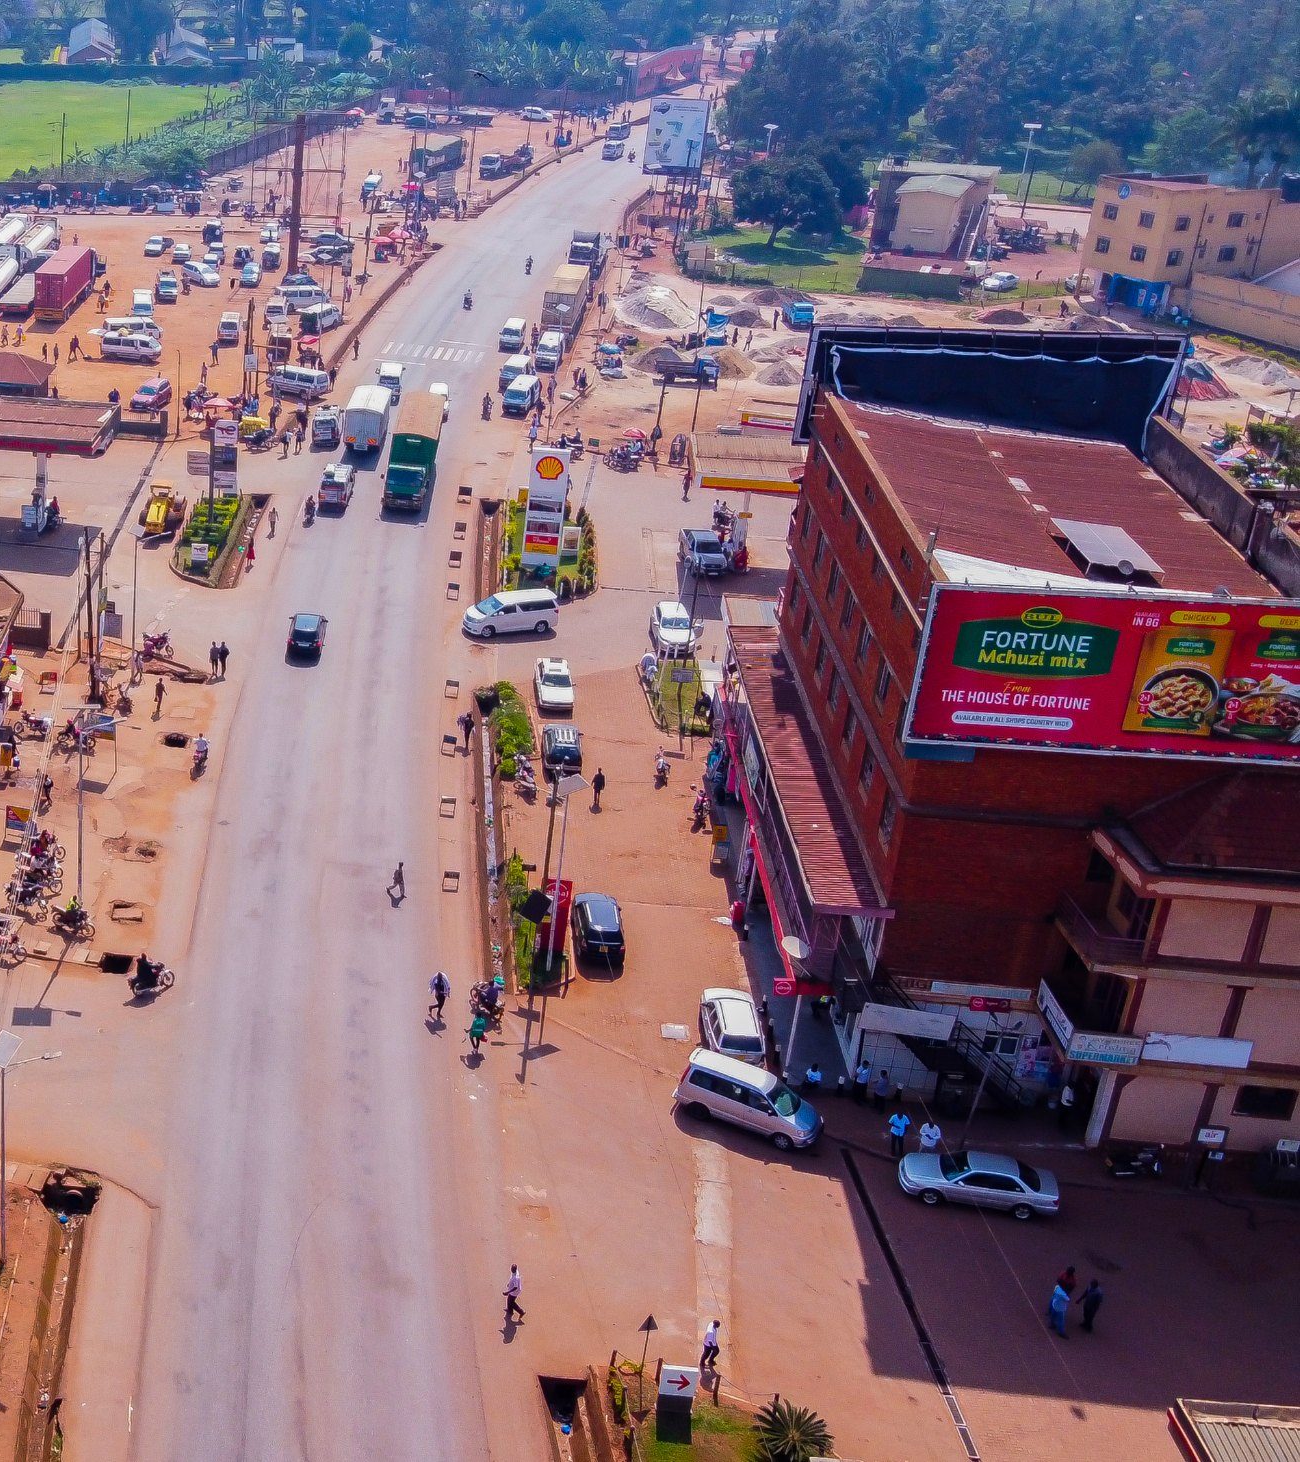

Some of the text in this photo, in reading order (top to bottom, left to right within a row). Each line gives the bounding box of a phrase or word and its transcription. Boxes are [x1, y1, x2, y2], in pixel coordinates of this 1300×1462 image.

[1132, 617, 1160, 627] IN 8G
[1183, 614, 1217, 622] CHICKEN
[981, 631, 1093, 653] FORTUNE
[978, 649, 1088, 669] Mchuzi mix
[1003, 682, 1032, 694] From
[941, 690, 1091, 710] THE HOUSE OF FORTUNE
[955, 714, 986, 722] AVAILABLE
[994, 715, 1004, 723] ALL
[1006, 716, 1025, 725] SHOPS
[1026, 718, 1054, 726] COUNTRY
[1070, 1051, 1139, 1064] SUPERMARKET
